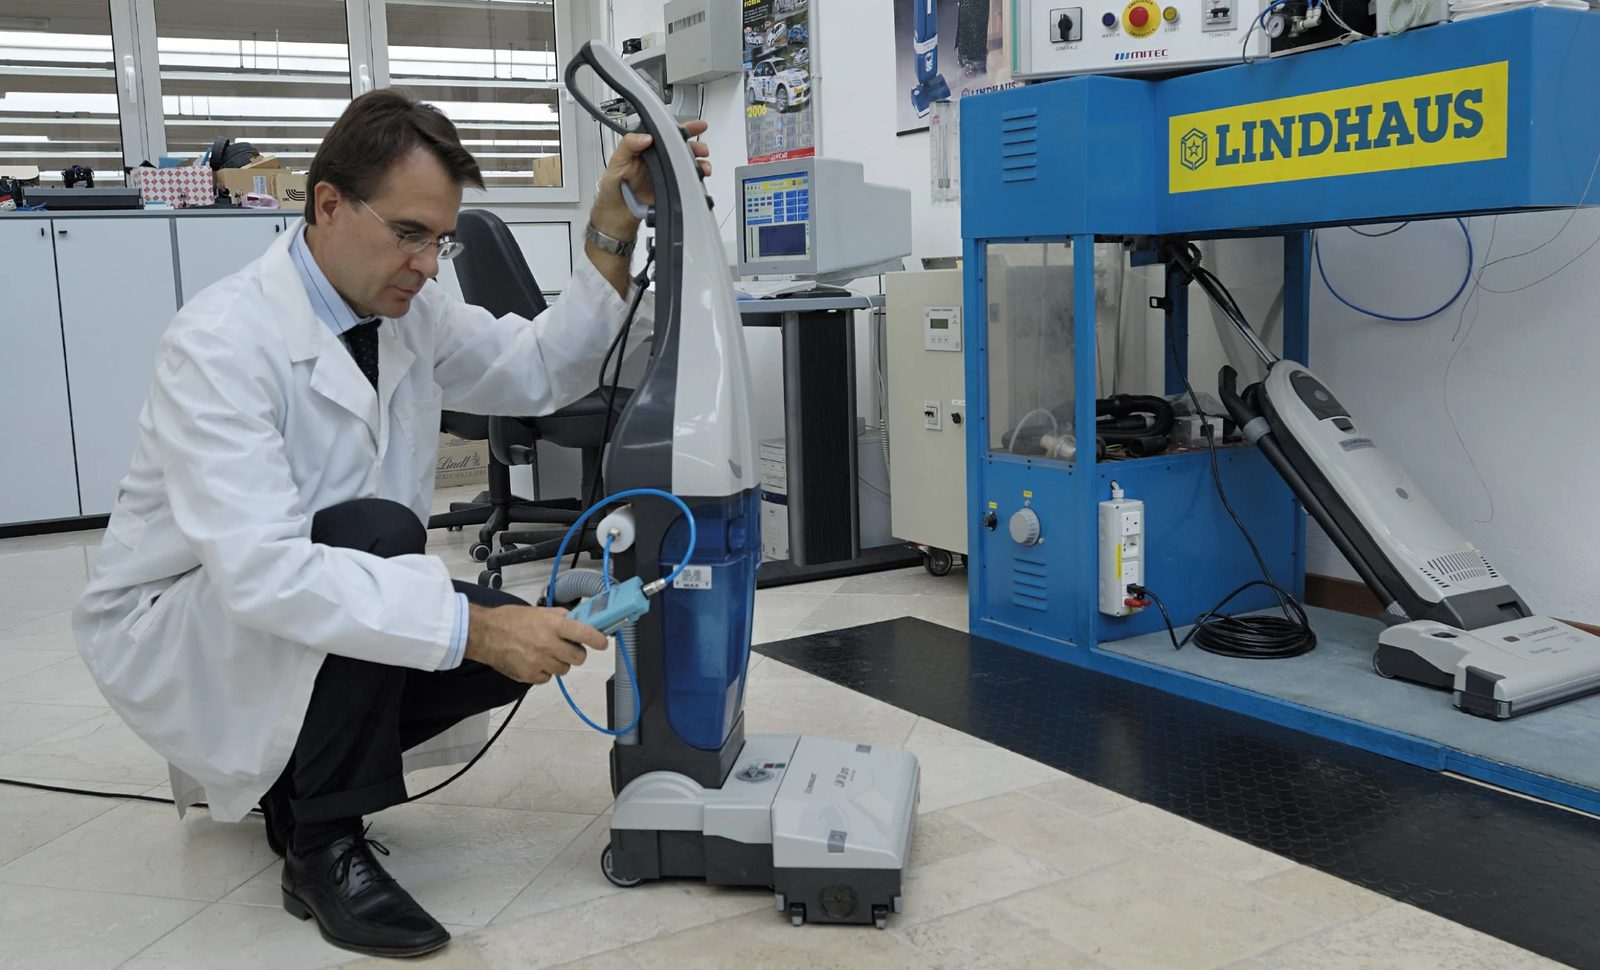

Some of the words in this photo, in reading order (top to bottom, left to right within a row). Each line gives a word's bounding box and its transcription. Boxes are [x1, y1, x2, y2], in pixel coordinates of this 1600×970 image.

[747, 104, 767, 118] 2006
[1214, 88, 1484, 167] LINDHAUS
[439, 455, 471, 470] Lindt
